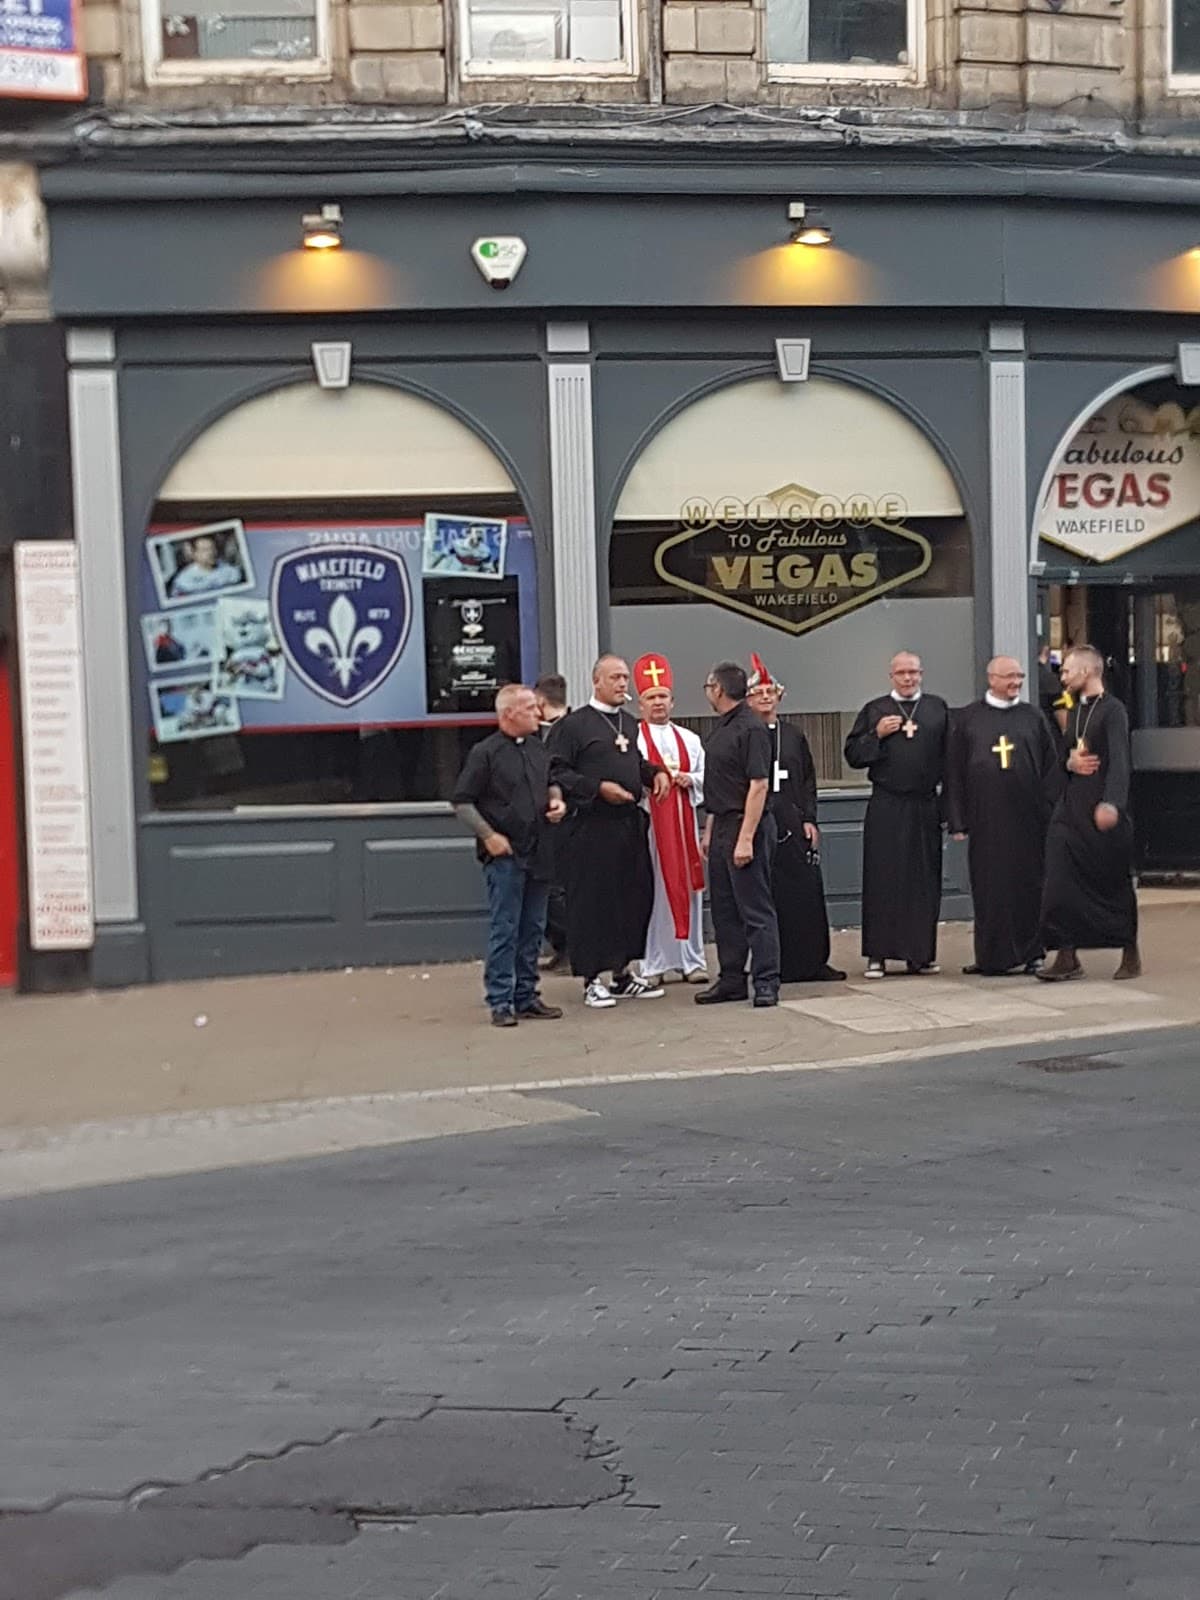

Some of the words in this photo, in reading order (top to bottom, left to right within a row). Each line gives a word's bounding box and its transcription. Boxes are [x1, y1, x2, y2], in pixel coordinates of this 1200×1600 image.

[1064, 440, 1184, 465] abulous
[684, 499, 902, 526] WELCOME
[1056, 518, 1146, 535] WAKEFIELD
[728, 533, 751, 548] TO
[756, 528, 847, 552] Fabulous
[295, 558, 386, 582] WAKEFIELD
[711, 553, 879, 590] VEGAS
[754, 593, 839, 606] WAKEFIELD
